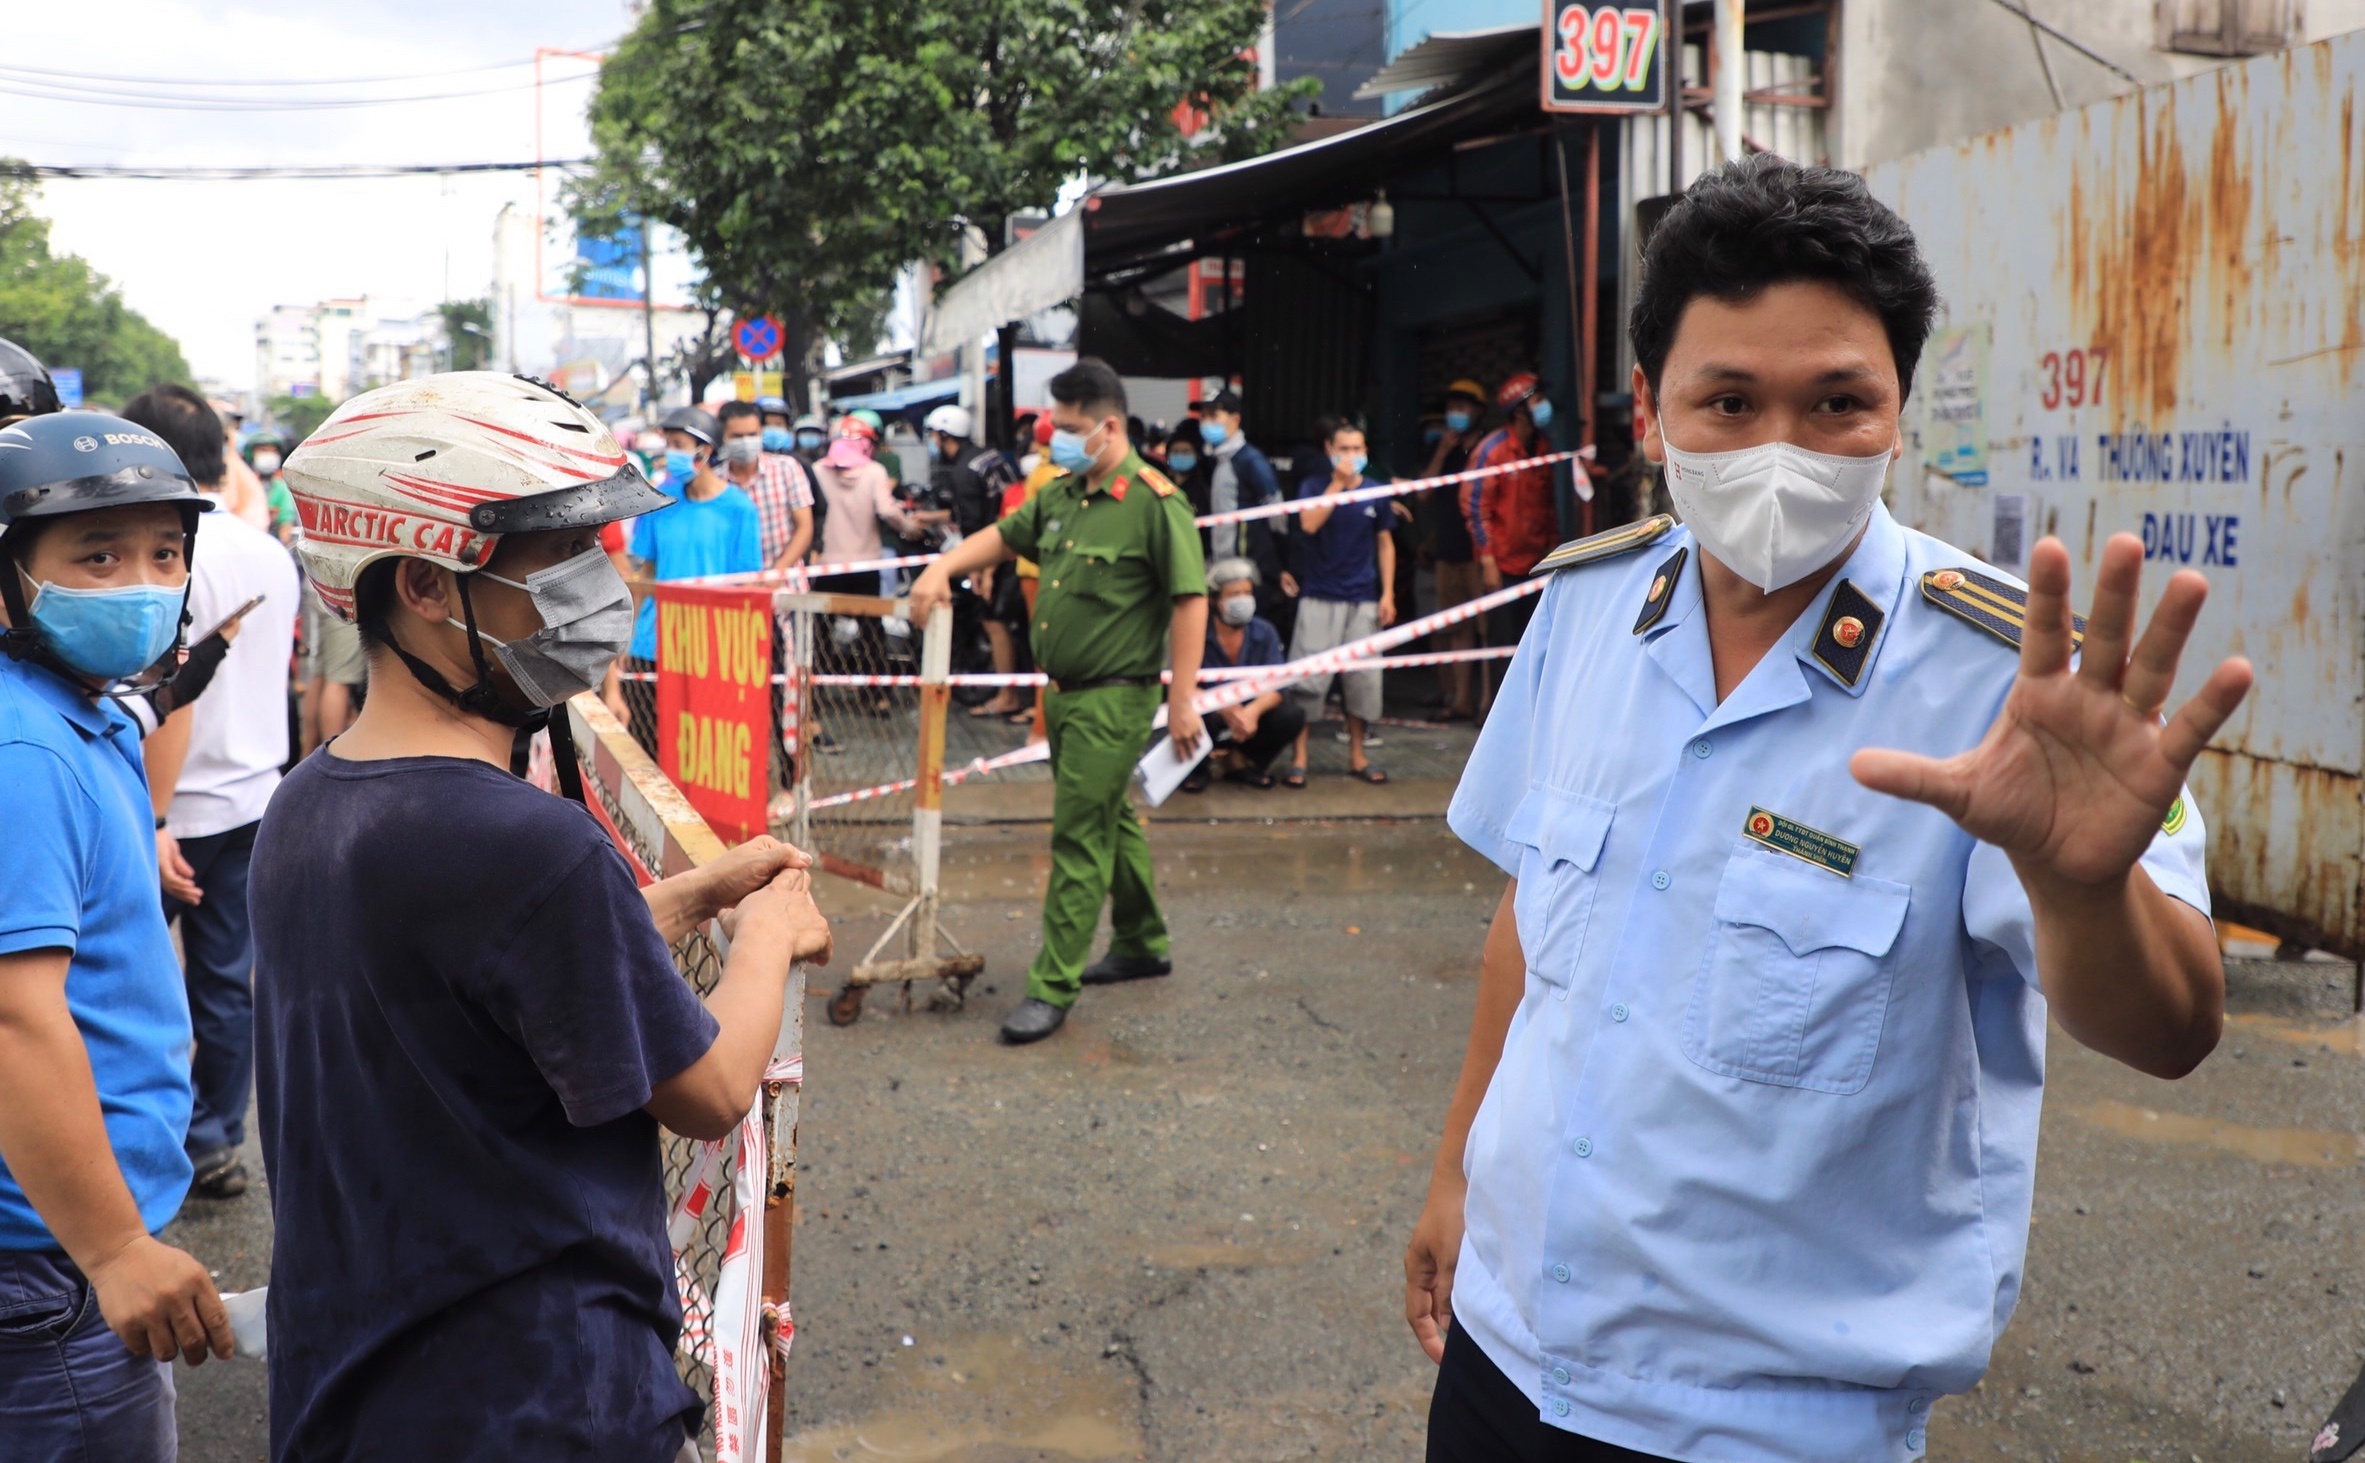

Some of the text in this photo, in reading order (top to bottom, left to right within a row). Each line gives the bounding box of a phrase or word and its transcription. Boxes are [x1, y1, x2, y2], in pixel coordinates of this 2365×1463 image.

[1556, 5, 1657, 90] 397
[2042, 346, 2111, 411] 397
[103, 433, 165, 450] BOSCH
[320, 503, 478, 554] ARCTIC CAT
[2202, 515, 2240, 567] XE
[661, 600, 768, 702] KHU VỰC
[677, 711, 751, 798] ĐANG
